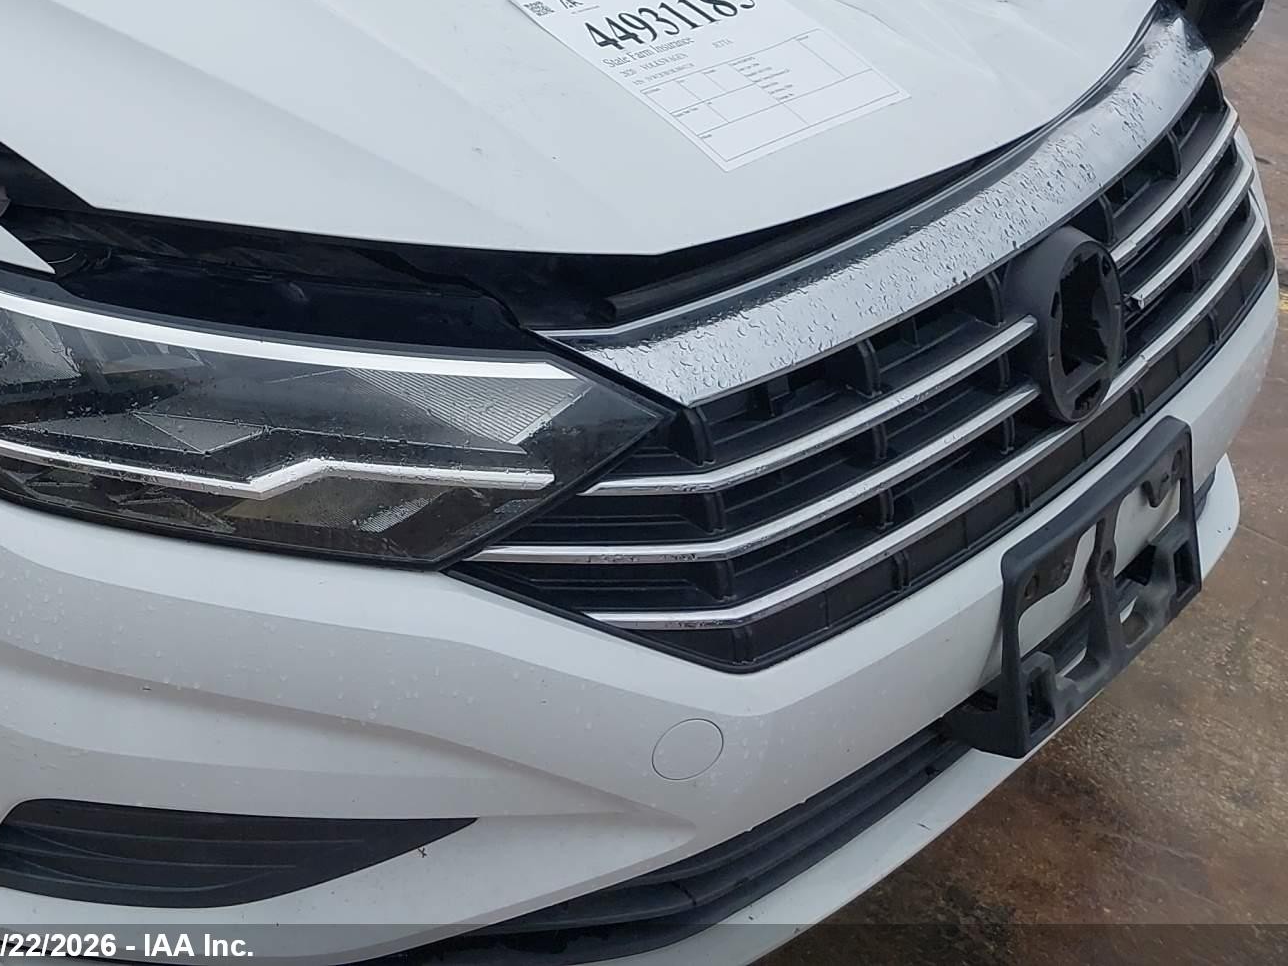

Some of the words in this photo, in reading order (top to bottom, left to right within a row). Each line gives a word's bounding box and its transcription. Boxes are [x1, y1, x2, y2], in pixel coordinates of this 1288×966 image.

[602, 54, 630, 68] State
[627, 46, 654, 61] Farm
[649, 36, 695, 54] Insurance
